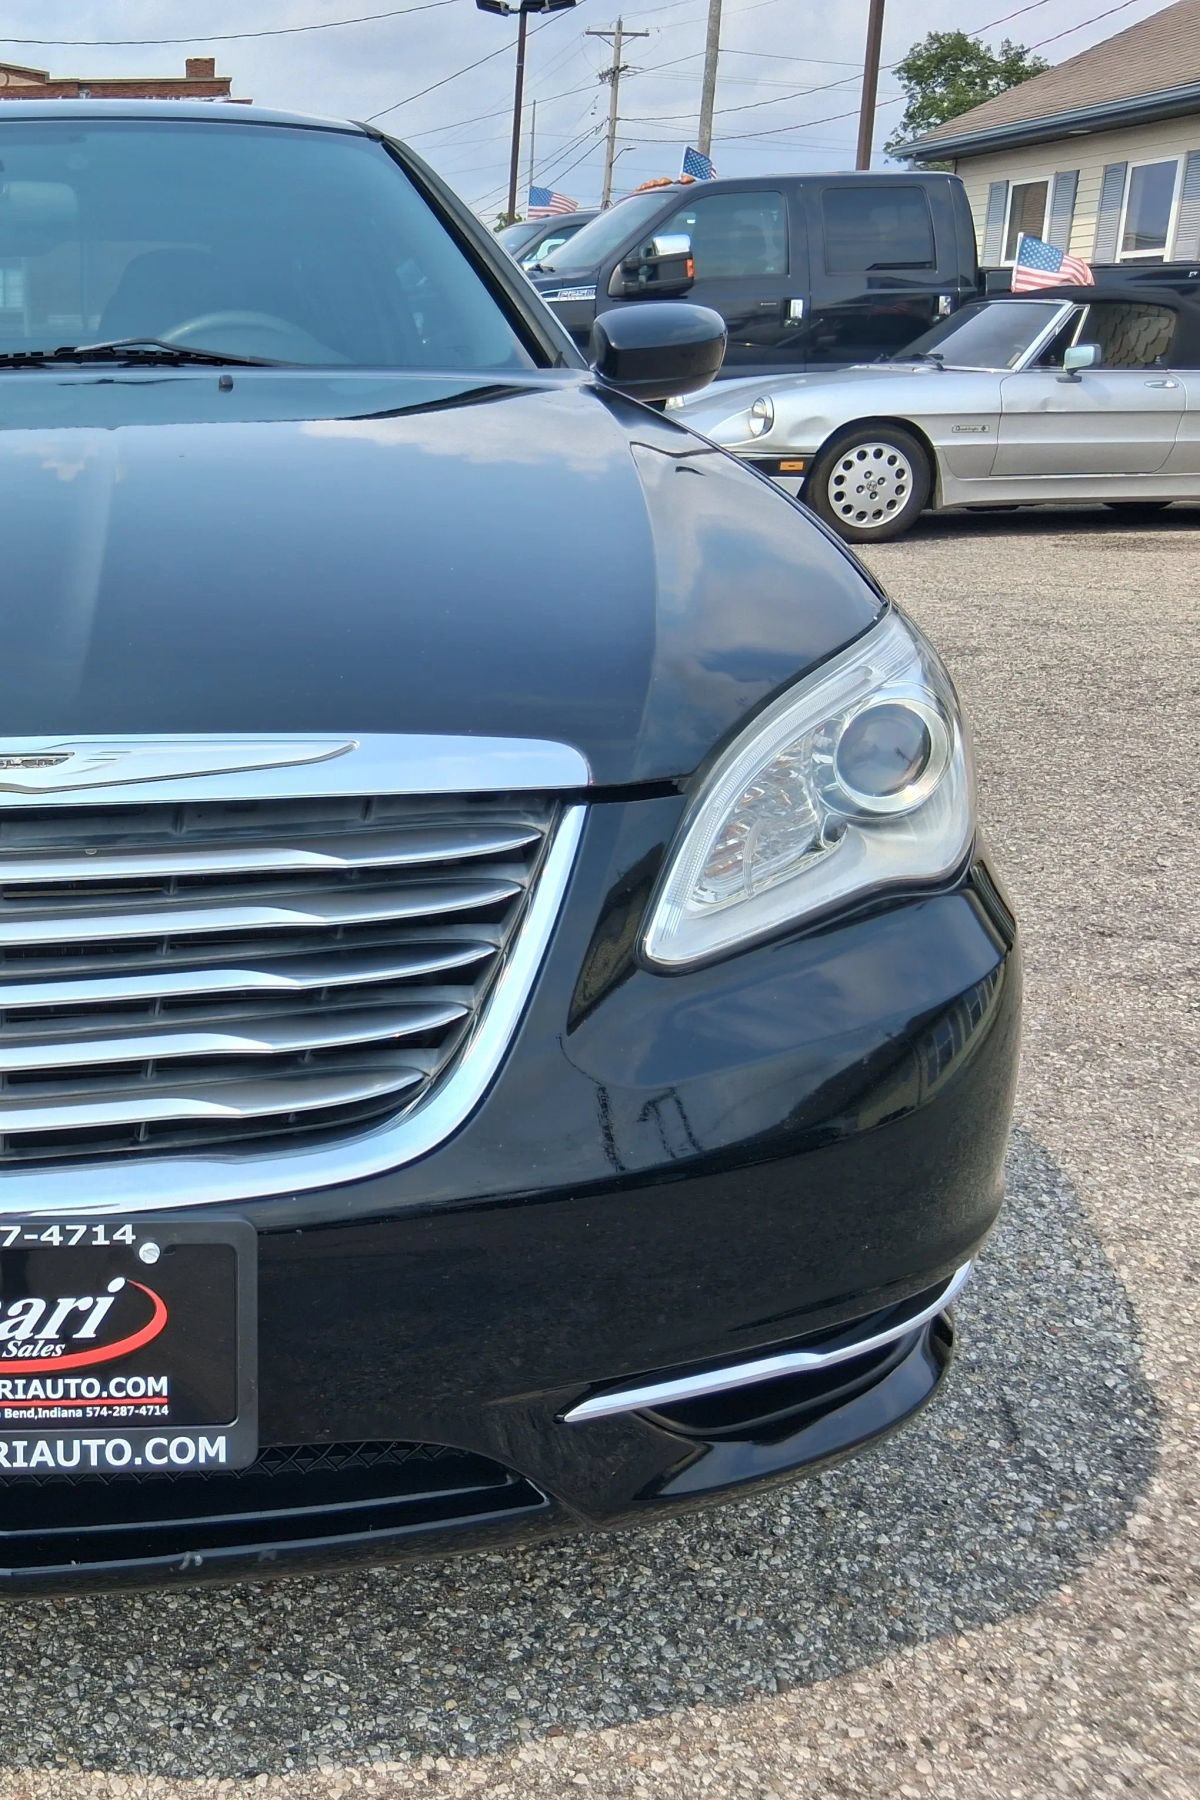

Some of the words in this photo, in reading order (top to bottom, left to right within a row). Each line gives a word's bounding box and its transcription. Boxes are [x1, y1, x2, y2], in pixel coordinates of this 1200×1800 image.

[1, 1339, 66, 1360] Sales
[4, 1407, 83, 1420] Bend,Indiana
[85, 1404, 169, 1417] 574-287-4714
